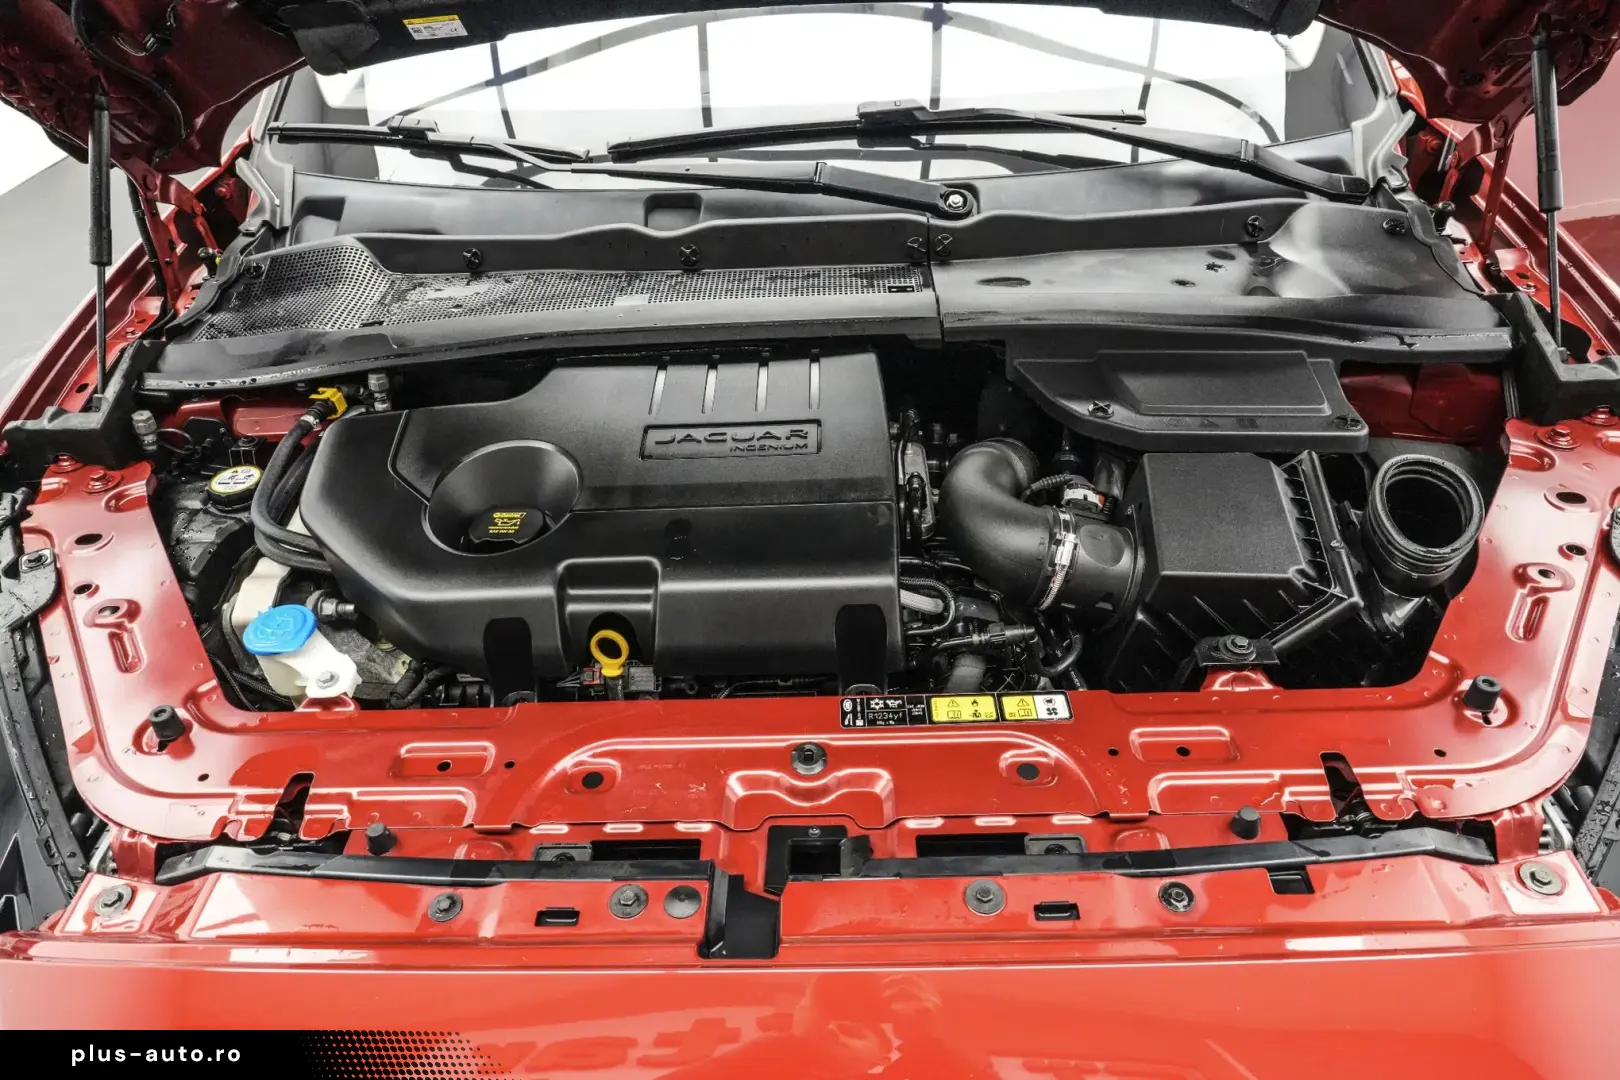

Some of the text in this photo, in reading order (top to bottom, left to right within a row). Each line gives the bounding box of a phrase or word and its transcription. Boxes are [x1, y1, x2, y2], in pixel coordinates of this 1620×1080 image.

[655, 429, 808, 445] JAGUAR
[729, 443, 808, 453] INGENIUM
[868, 712, 903, 720] R1234yf
